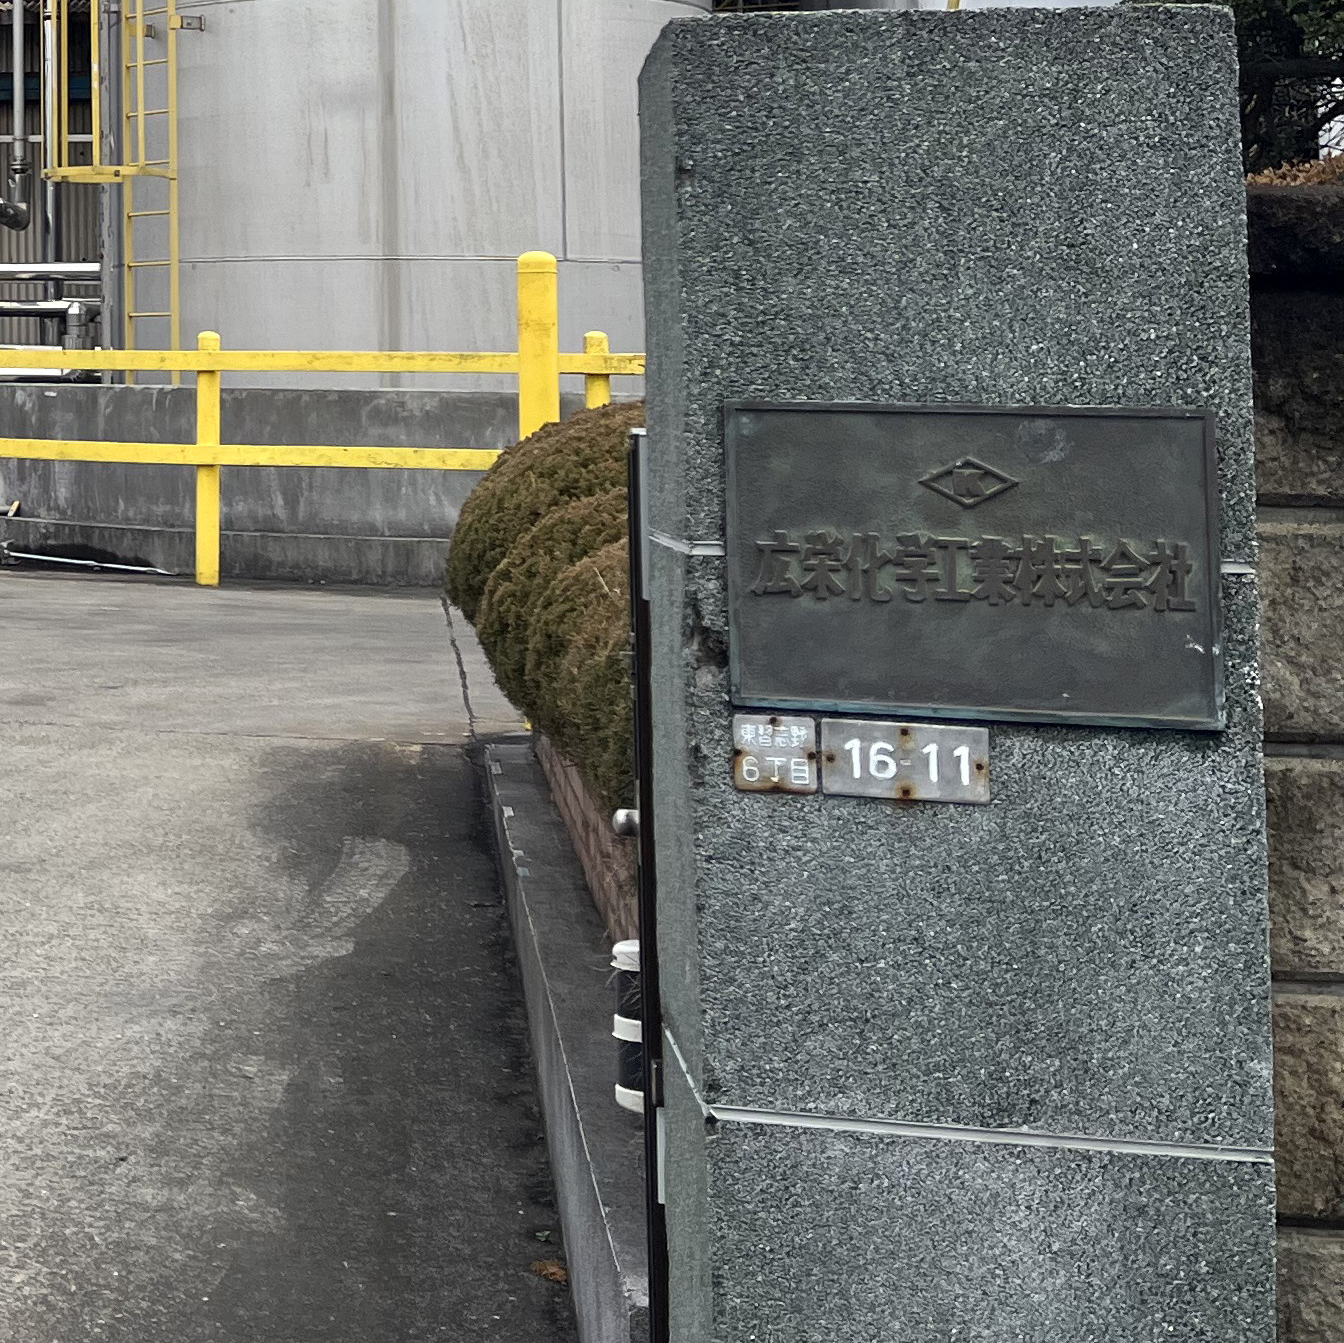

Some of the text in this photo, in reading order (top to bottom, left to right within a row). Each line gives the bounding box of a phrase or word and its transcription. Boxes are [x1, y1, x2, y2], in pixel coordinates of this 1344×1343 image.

[750, 529, 1196, 613] 広栄化学工業株式会社
[740, 724, 808, 748] 東習志野
[742, 756, 809, 784] 6丁目
